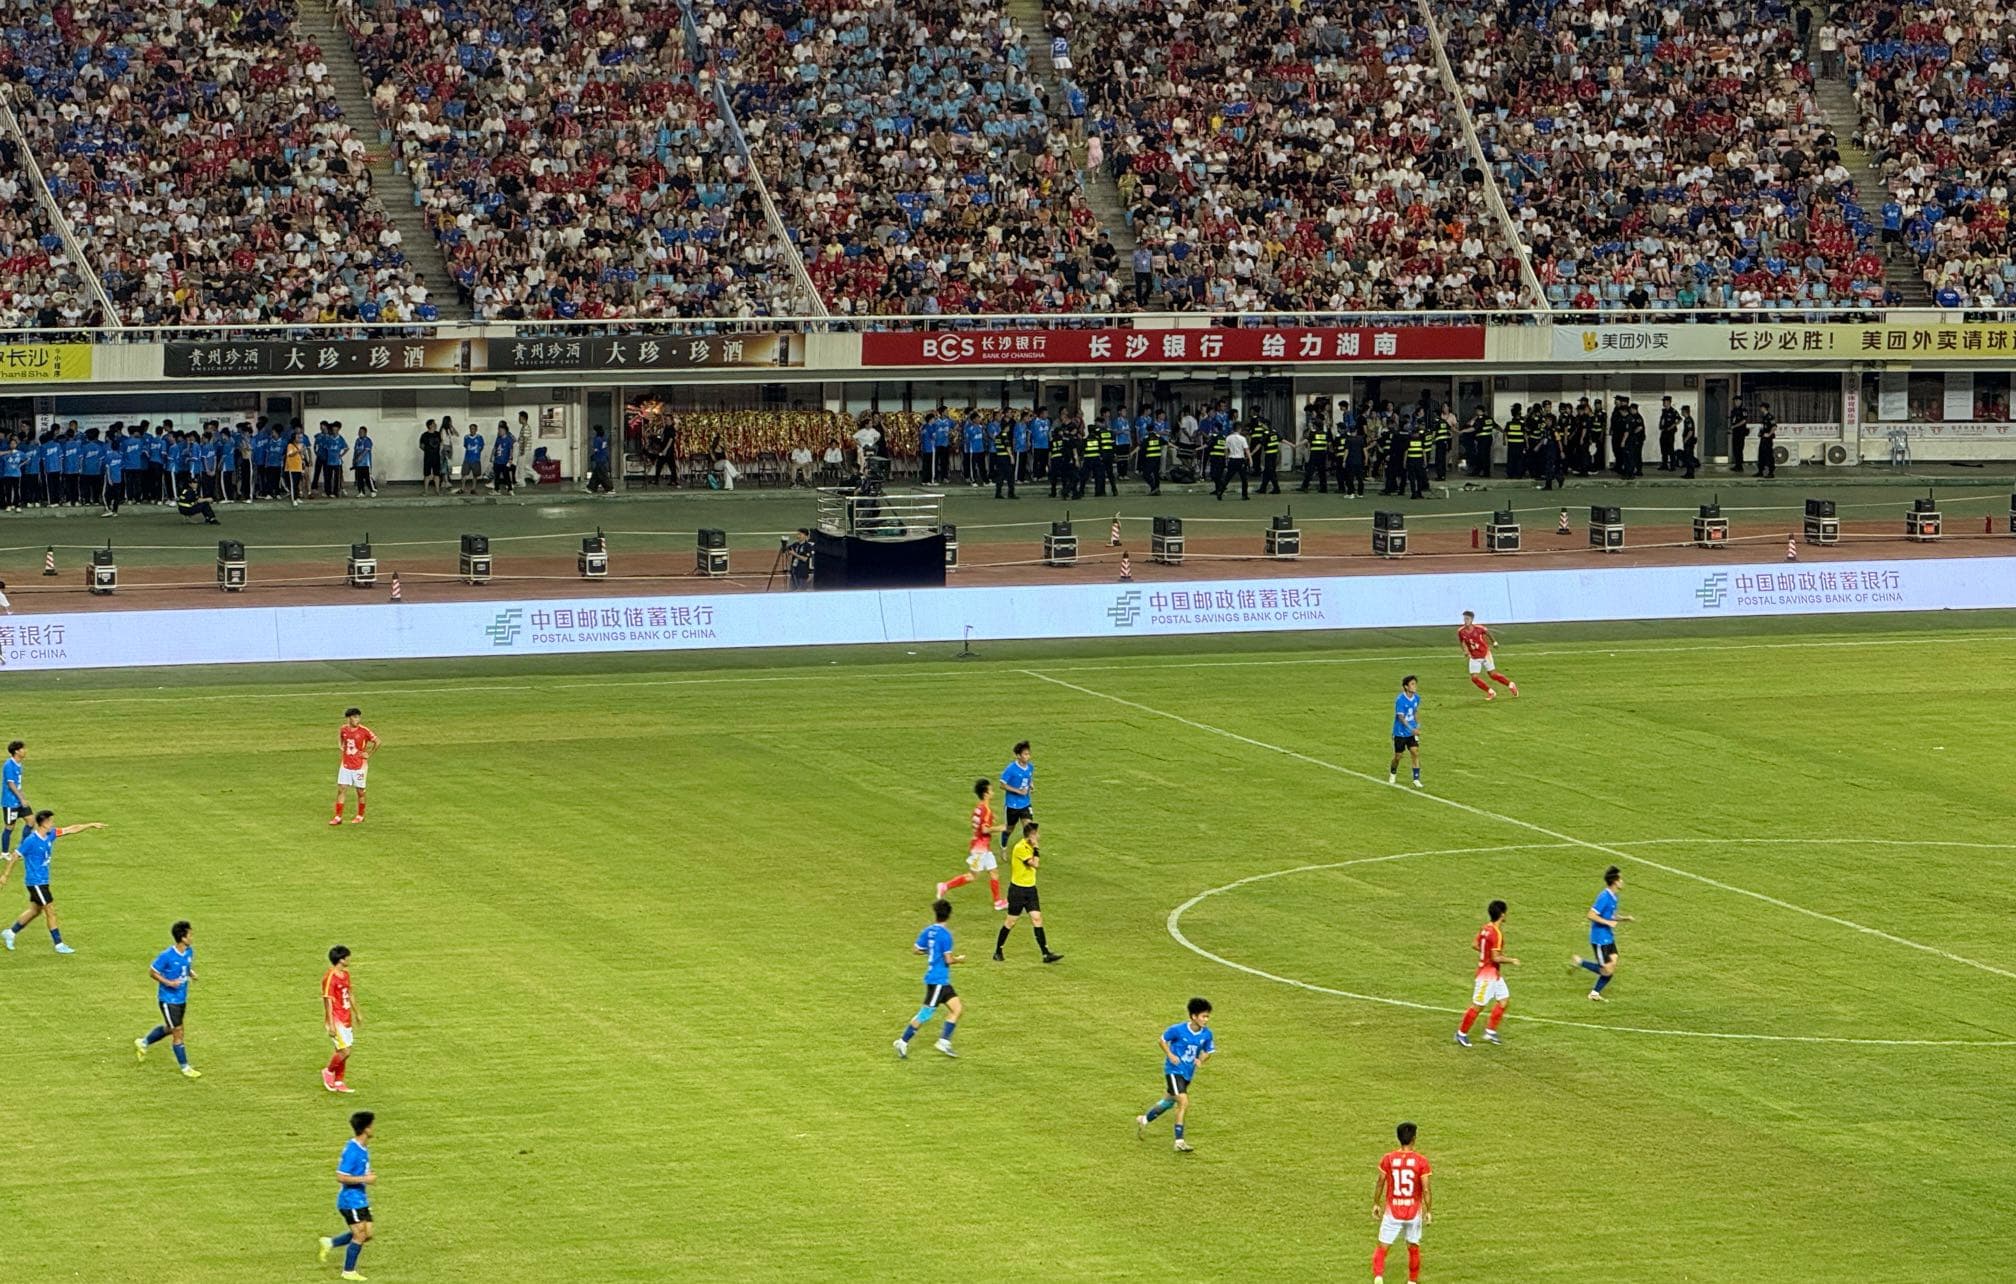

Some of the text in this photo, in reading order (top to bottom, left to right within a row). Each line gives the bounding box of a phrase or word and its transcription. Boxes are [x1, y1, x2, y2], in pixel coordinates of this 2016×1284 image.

[923, 338, 975, 357] BCS
[982, 336, 1046, 350] 长沙银行
[1089, 333, 1397, 358] 长沙银行 给力湖南
[1602, 333, 1669, 349] 美团外卖
[0, 348, 48, 367] 长沙
[1736, 570, 1900, 593] 中国邮政储蓄银行
[1150, 588, 1322, 612] 中国邮政储蓄银行
[1737, 592, 1903, 605] POSTAL SAVINGS BANK OF CHINA
[531, 605, 714, 630] 中国邮政储蓄银行
[1151, 610, 1325, 624] POSTAL SAVINGS BANK OF CHINA
[532, 628, 716, 643] POSTAL SAVINGS BANK OF CHINA
[10, 649, 67, 660] OF CHINA
[1392, 1169, 1415, 1196] 15
